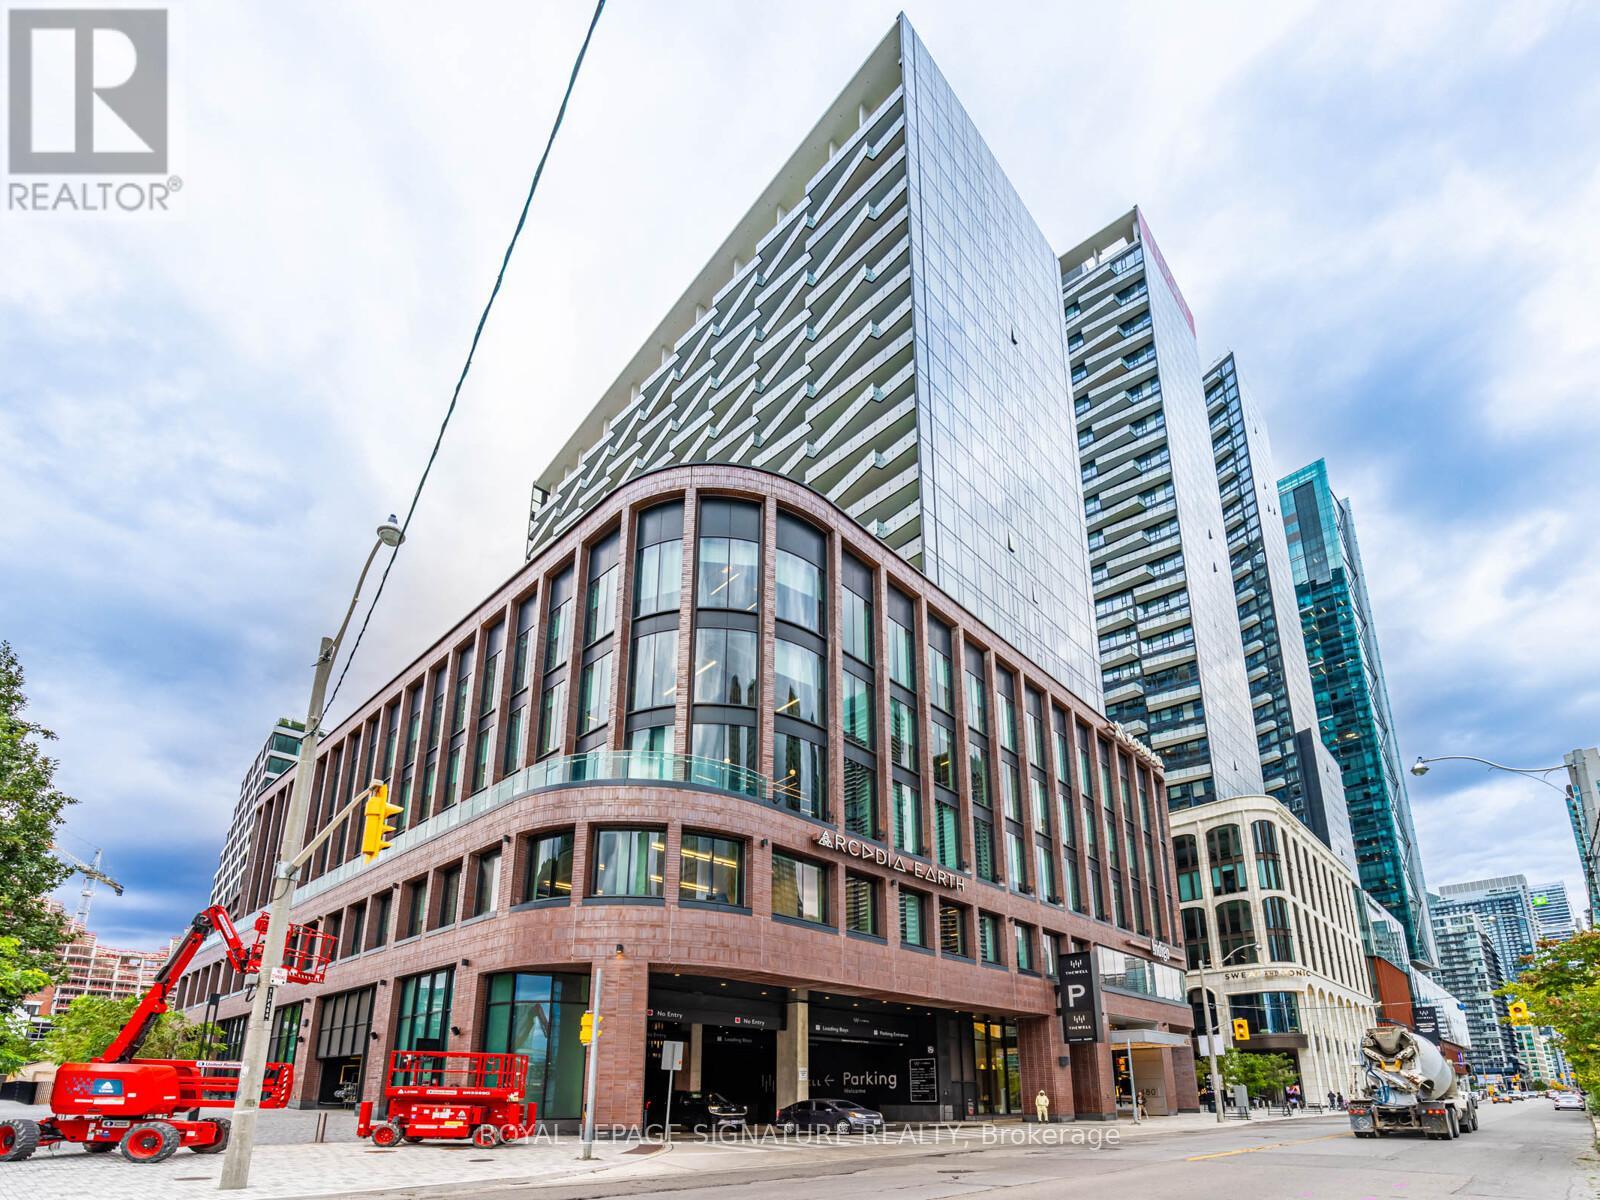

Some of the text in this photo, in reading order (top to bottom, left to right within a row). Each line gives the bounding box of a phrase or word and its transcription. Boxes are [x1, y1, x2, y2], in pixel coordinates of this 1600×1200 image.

[818, 830, 965, 893] ARCADIA EARTH
[1067, 984, 1086, 1008] P
[667, 1011, 683, 1019] Entry
[843, 1070, 897, 1090] Parking
